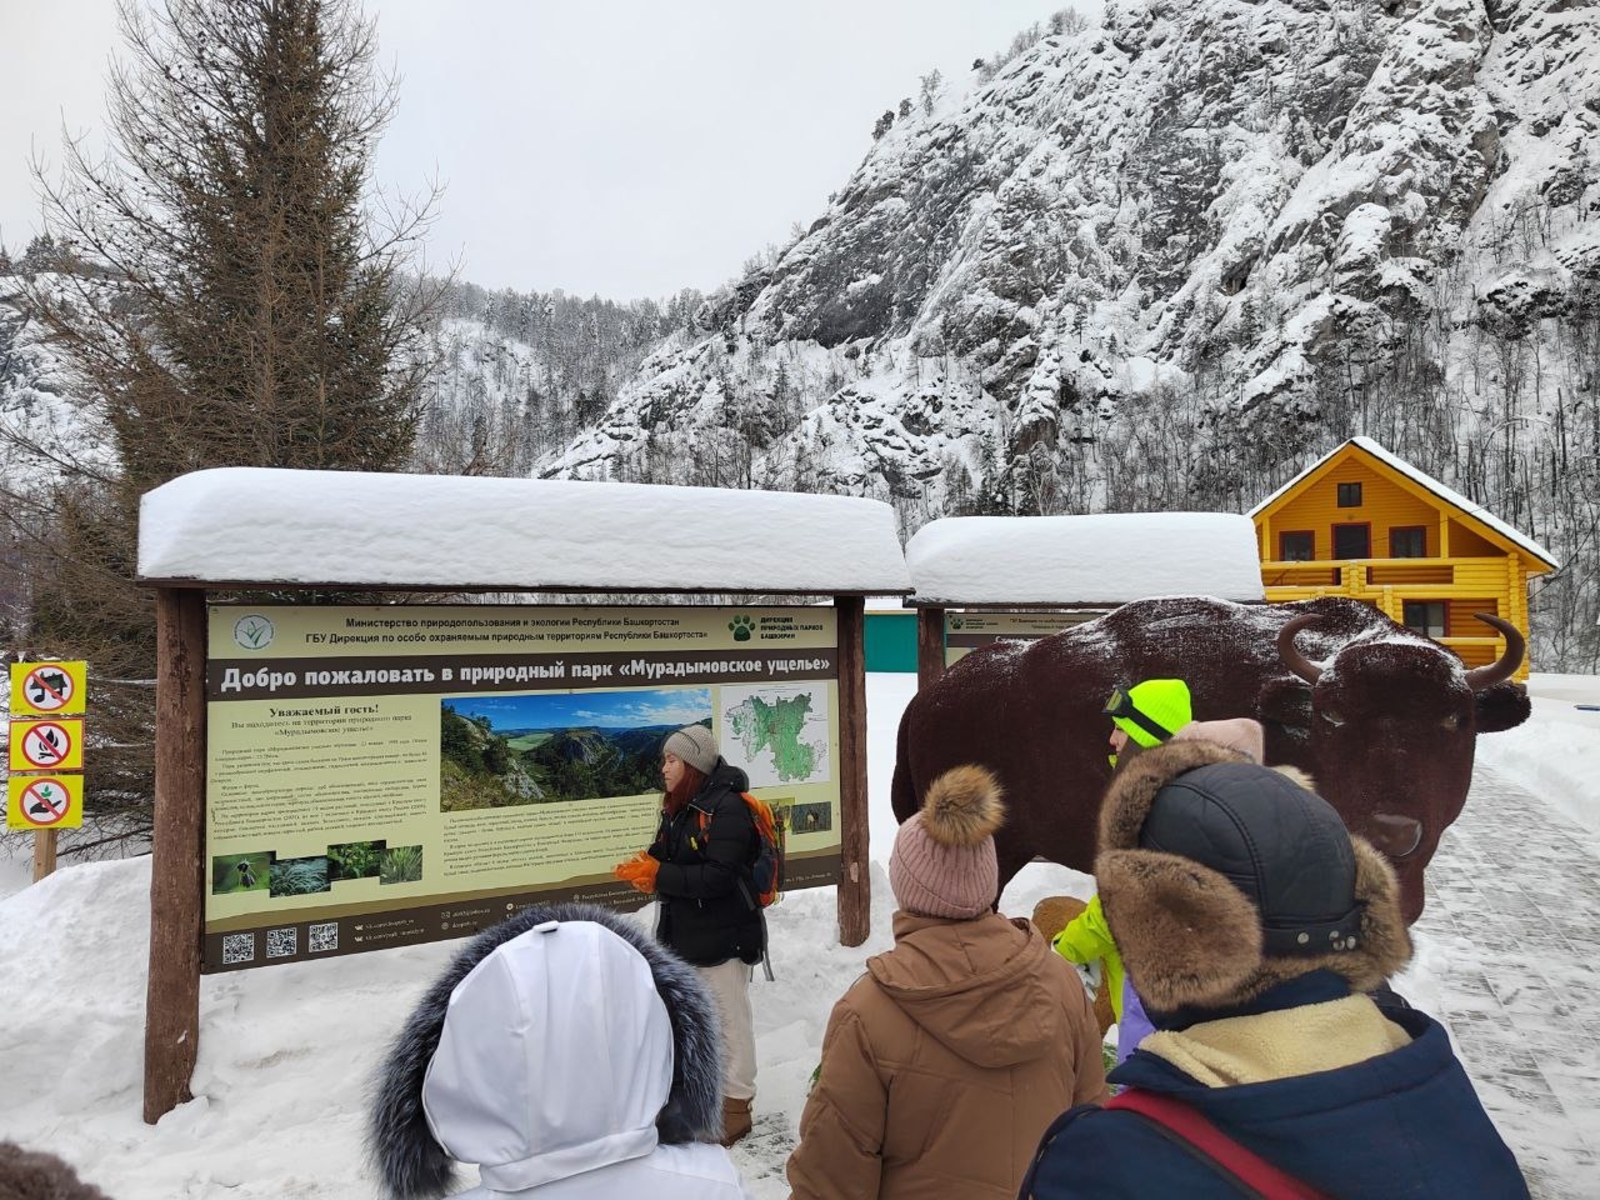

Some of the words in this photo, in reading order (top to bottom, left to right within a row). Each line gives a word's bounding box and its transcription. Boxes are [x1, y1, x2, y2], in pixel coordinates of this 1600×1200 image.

[345, 618, 418, 629] Министерство
[421, 618, 521, 630] природопользования
[531, 618, 571, 628] экологии
[572, 617, 621, 628] Республики
[623, 617, 680, 628] Башкортостан
[305, 634, 327, 643] ГБУ
[329, 633, 380, 645] Дирекция
[382, 635, 395, 643] по
[397, 633, 426, 643] особо
[429, 633, 490, 643] охраняемым
[492, 633, 545, 643] природным
[547, 632, 602, 642] территориям
[603, 631, 652, 642] Республики
[653, 630, 708, 641] Башкортостан
[220, 667, 297, 692] Добро
[304, 666, 435, 686] пожаловать
[442, 666, 453, 681] в
[460, 660, 565, 685] природный
[571, 663, 613, 683] парк
[619, 659, 762, 679] «Мурадымовское
[767, 657, 830, 674] ущелье»
[269, 705, 341, 718] Уважаемый
[344, 703, 379, 715] гость!
